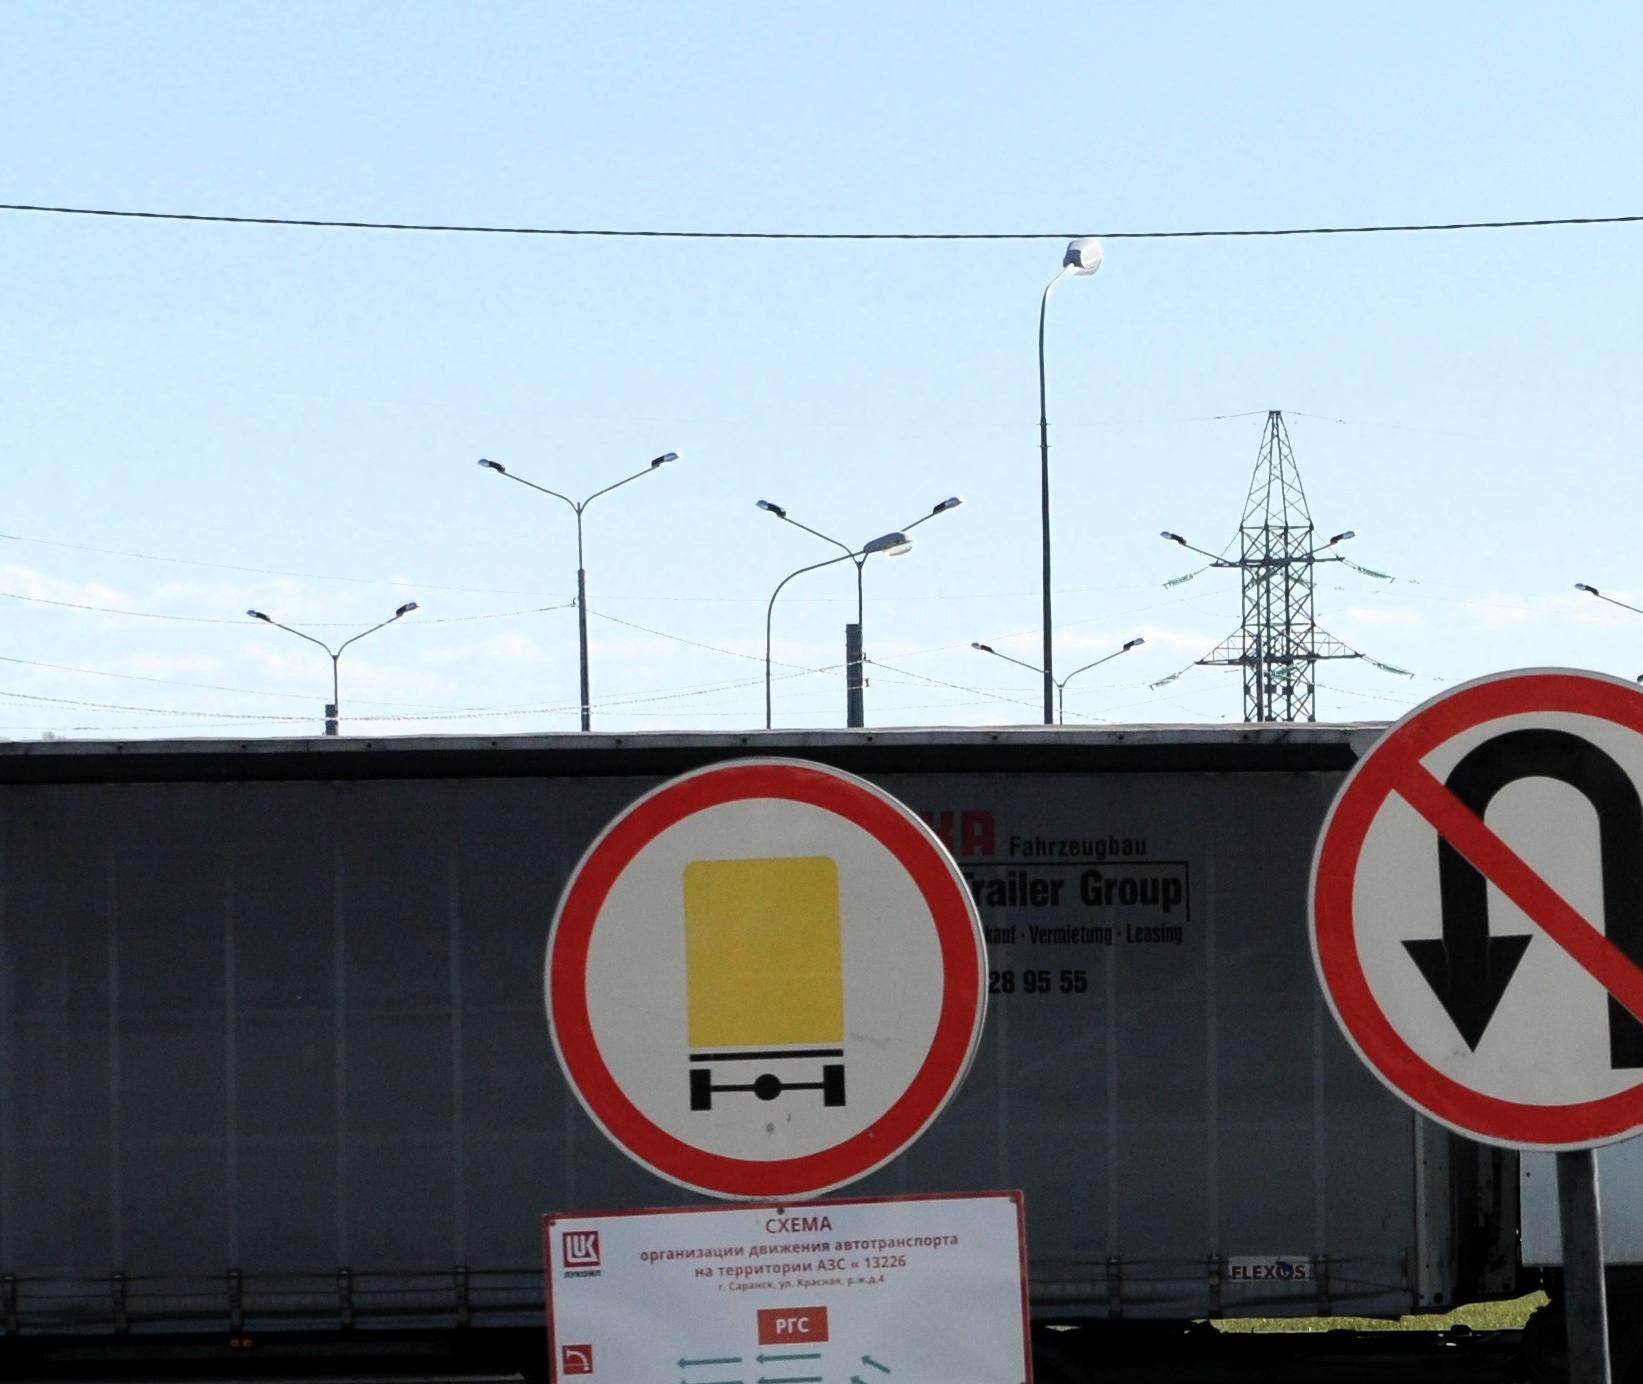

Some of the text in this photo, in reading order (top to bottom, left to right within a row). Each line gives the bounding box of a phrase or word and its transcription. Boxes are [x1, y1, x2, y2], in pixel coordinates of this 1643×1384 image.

[1009, 835, 1147, 859] Fahrzeugbau
[964, 869, 1182, 913] railer Group
[1029, 924, 1112, 945] Vermietung
[1127, 923, 1183, 945] Leasing
[1024, 970, 1051, 993] 95
[1060, 970, 1087, 993] 55
[765, 1215, 832, 1234] СХЕМА
[640, 1235, 958, 1264] организации движения автотранспорта
[695, 1266, 713, 1278] на
[719, 1261, 812, 1279] территории
[817, 1258, 845, 1272] АЗС
[776, 1317, 810, 1334] РГС
